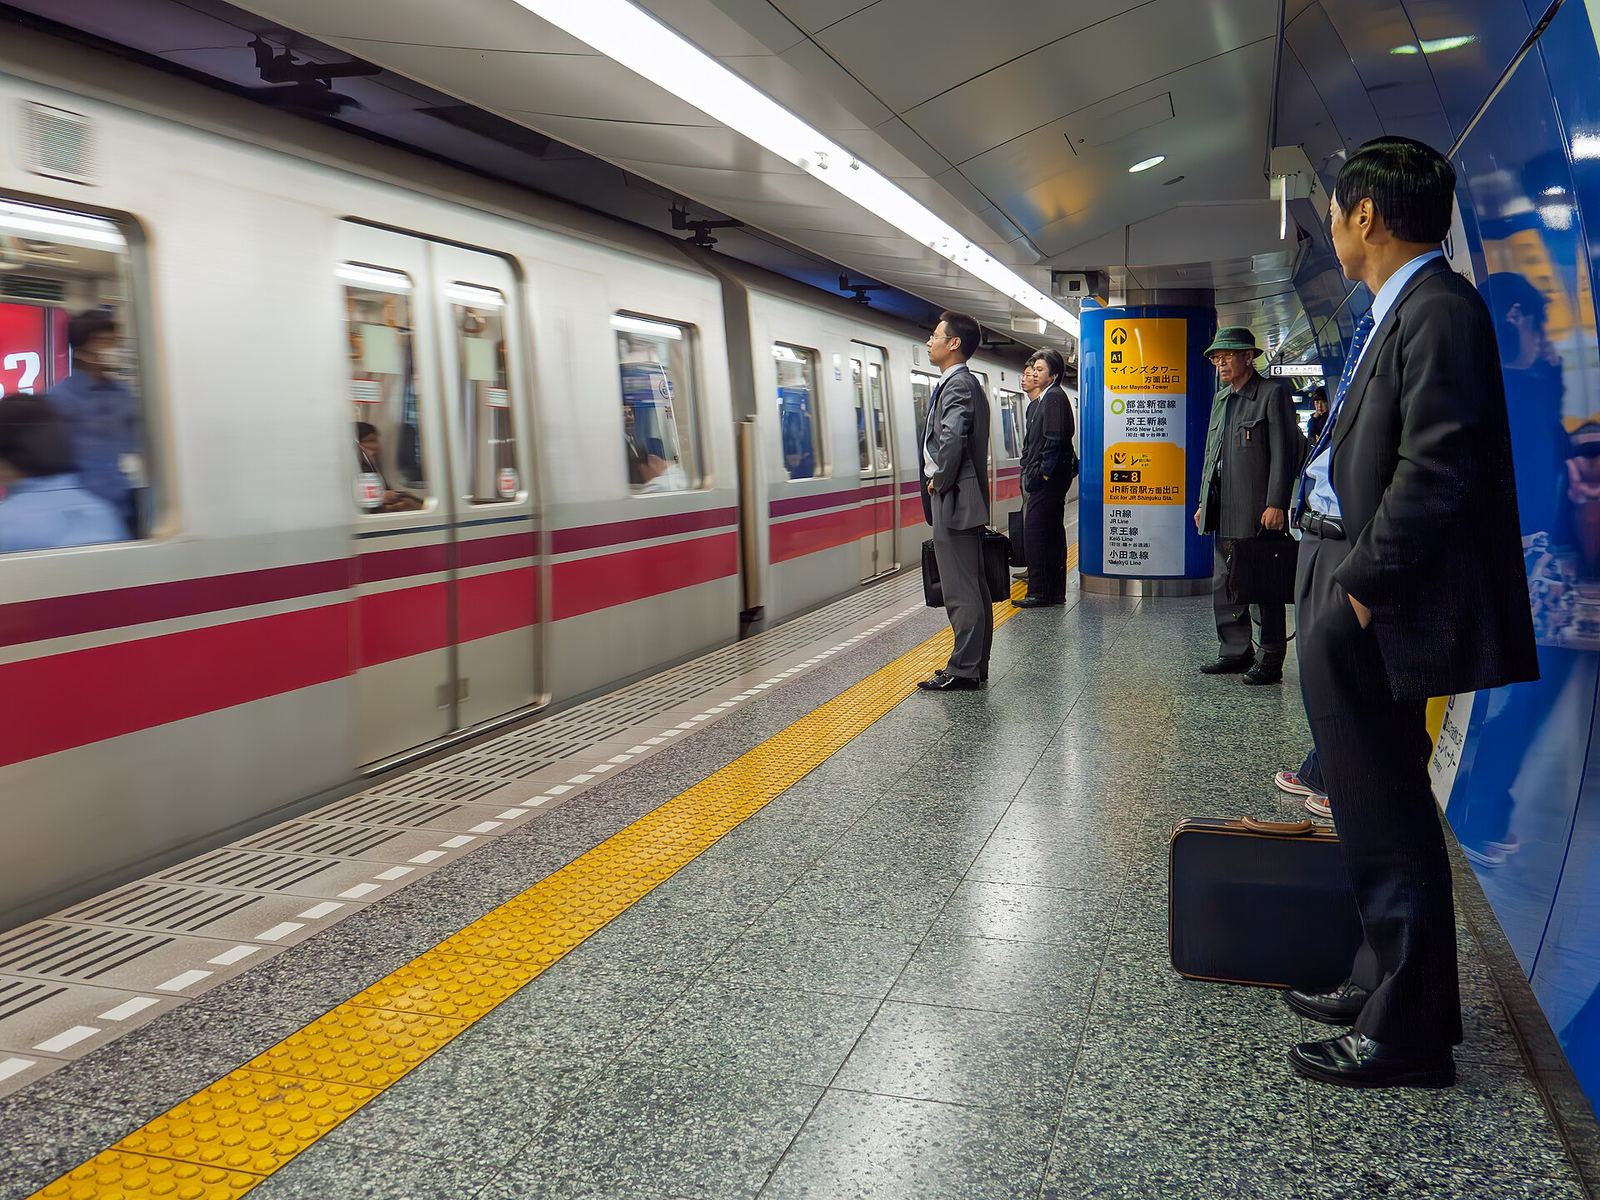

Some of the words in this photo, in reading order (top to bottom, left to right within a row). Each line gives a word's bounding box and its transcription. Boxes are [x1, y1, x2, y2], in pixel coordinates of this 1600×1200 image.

[1111, 365, 1179, 374] マインズタワー
[1144, 375, 1180, 383] 方面出口
[1126, 399, 1177, 408] 都営新宿線
[1126, 417, 1168, 426] 京王新線
[1110, 485, 1179, 494] JR新宿駅方面出口
[1110, 509, 1132, 518] JR線
[1110, 526, 1139, 536] 京王線
[1110, 550, 1149, 560] 小田急線
